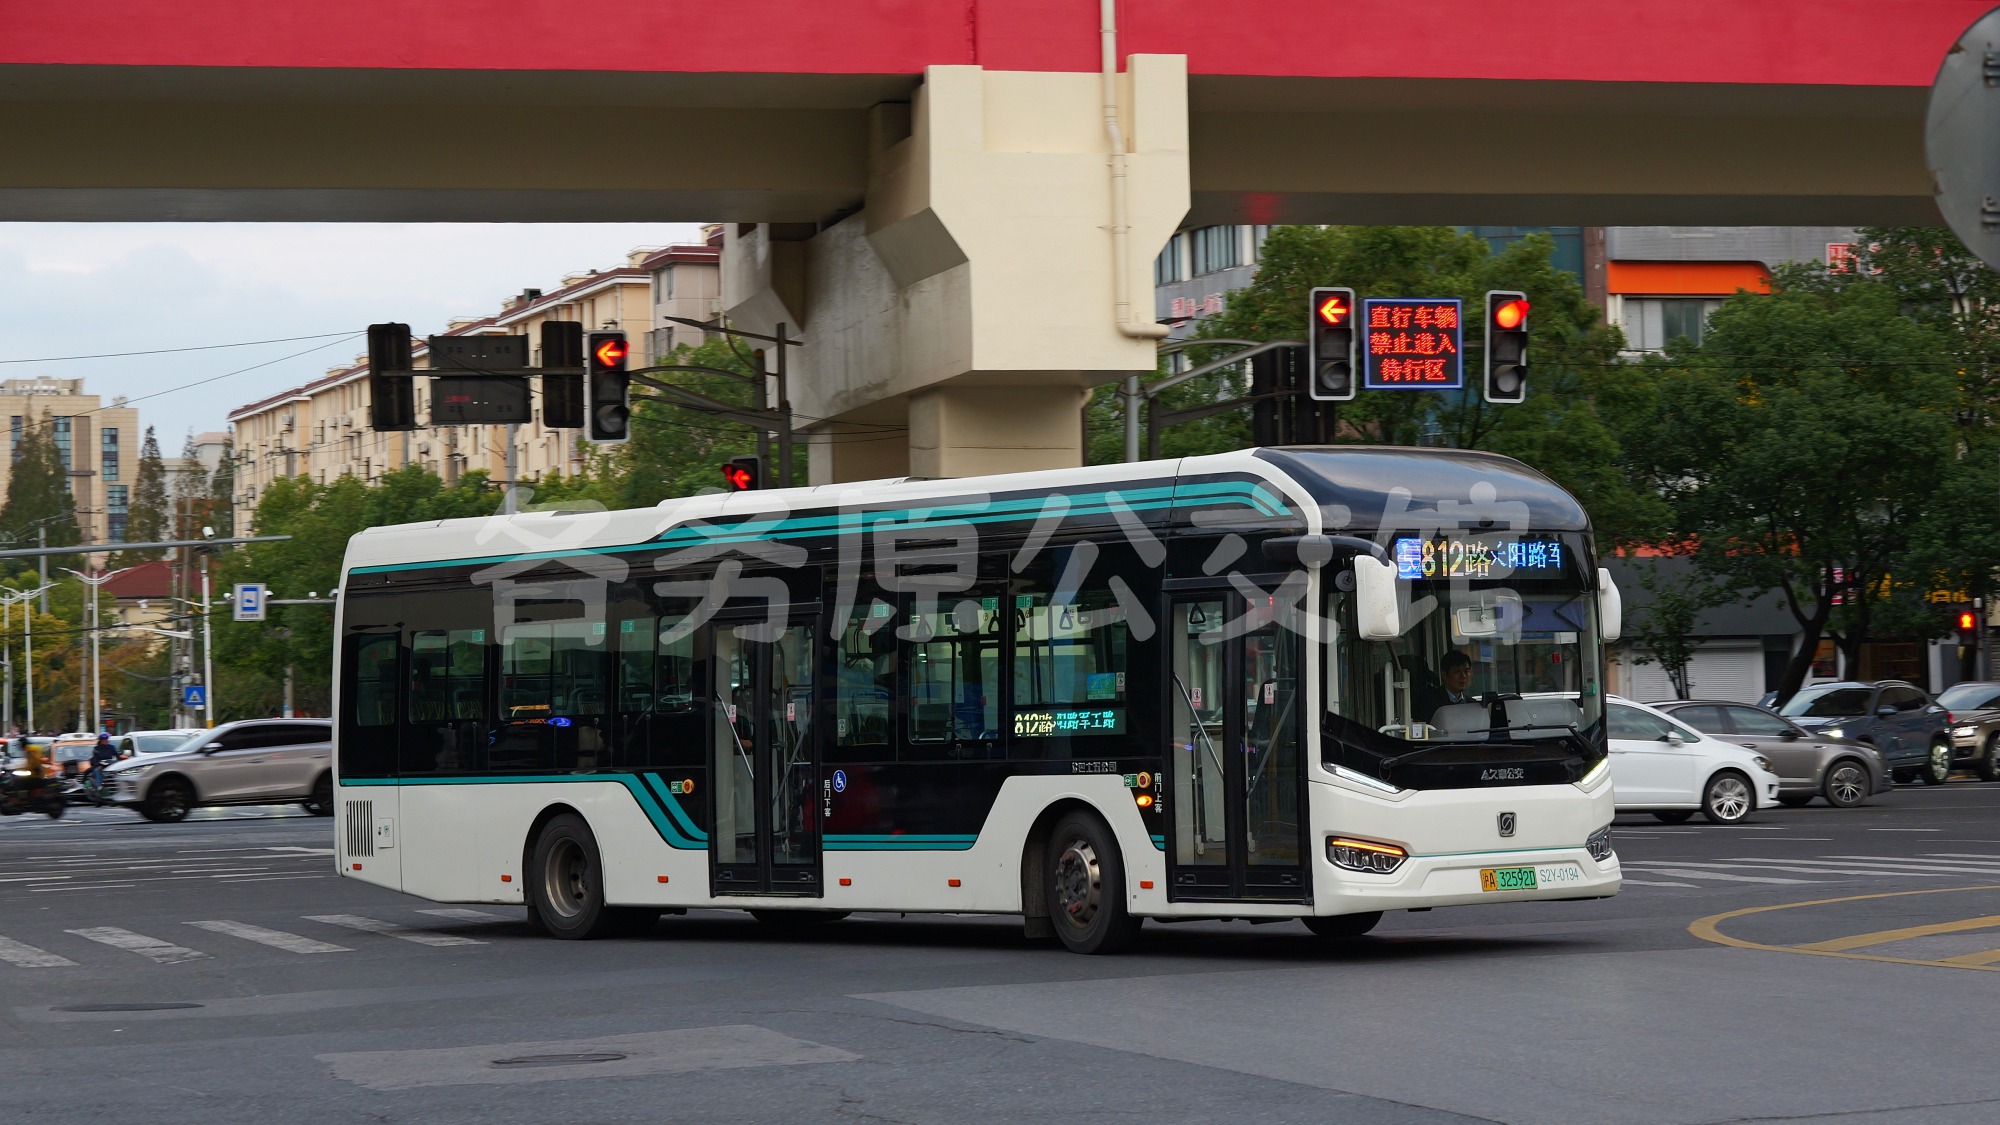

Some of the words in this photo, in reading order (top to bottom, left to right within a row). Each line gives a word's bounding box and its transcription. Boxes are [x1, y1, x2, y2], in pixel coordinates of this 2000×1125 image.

[1369, 305, 1458, 329] 直行车辆
[1380, 358, 1447, 382] 待行区
[824, 779, 832, 817] 后门下客
[1154, 772, 1163, 814] 前门上客
[1540, 867, 1579, 883] S2Y-0194
